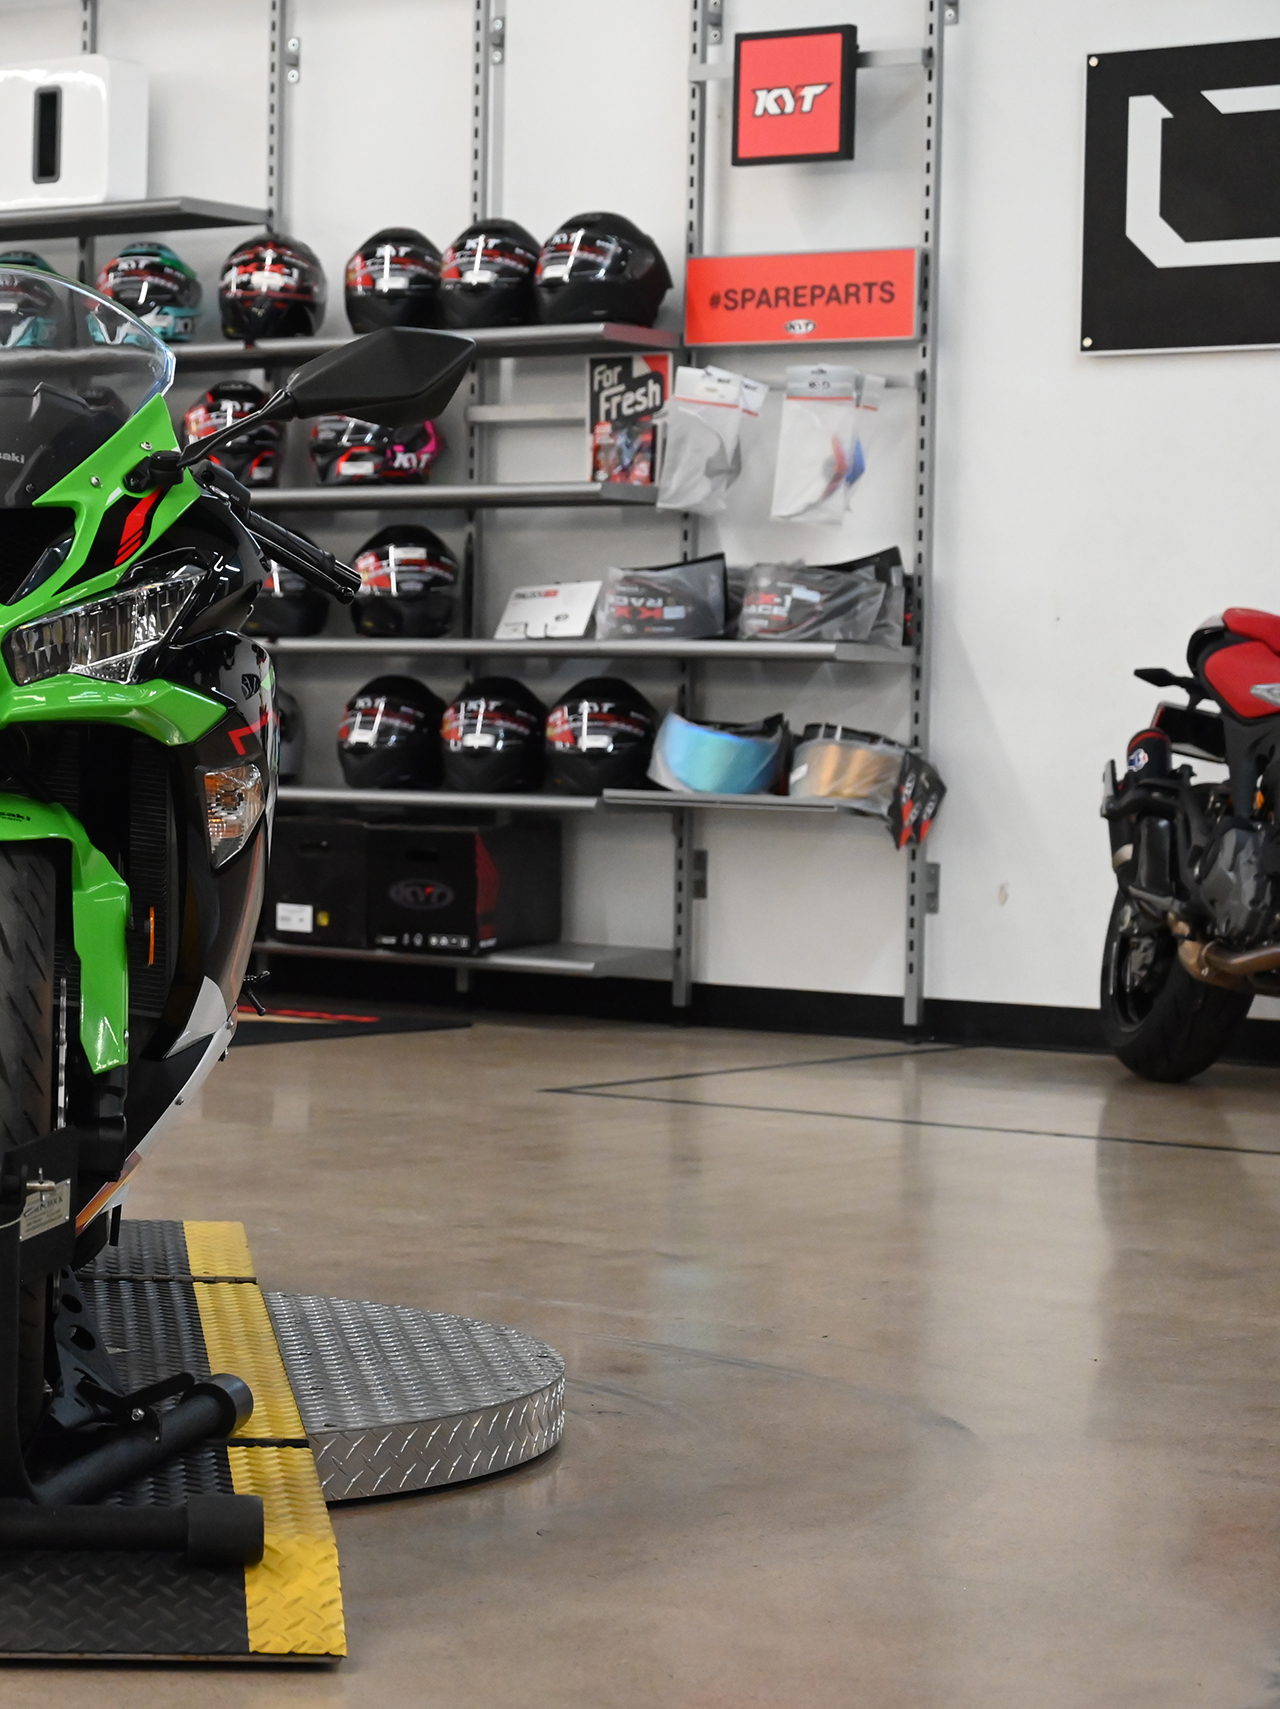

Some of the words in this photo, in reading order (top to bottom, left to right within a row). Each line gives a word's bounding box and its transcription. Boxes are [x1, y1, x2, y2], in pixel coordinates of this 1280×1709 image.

[753, 83, 833, 117] KYT
[709, 280, 896, 312] #SPAREPARTS
[593, 364, 623, 392] For
[599, 379, 661, 423] Fresh
